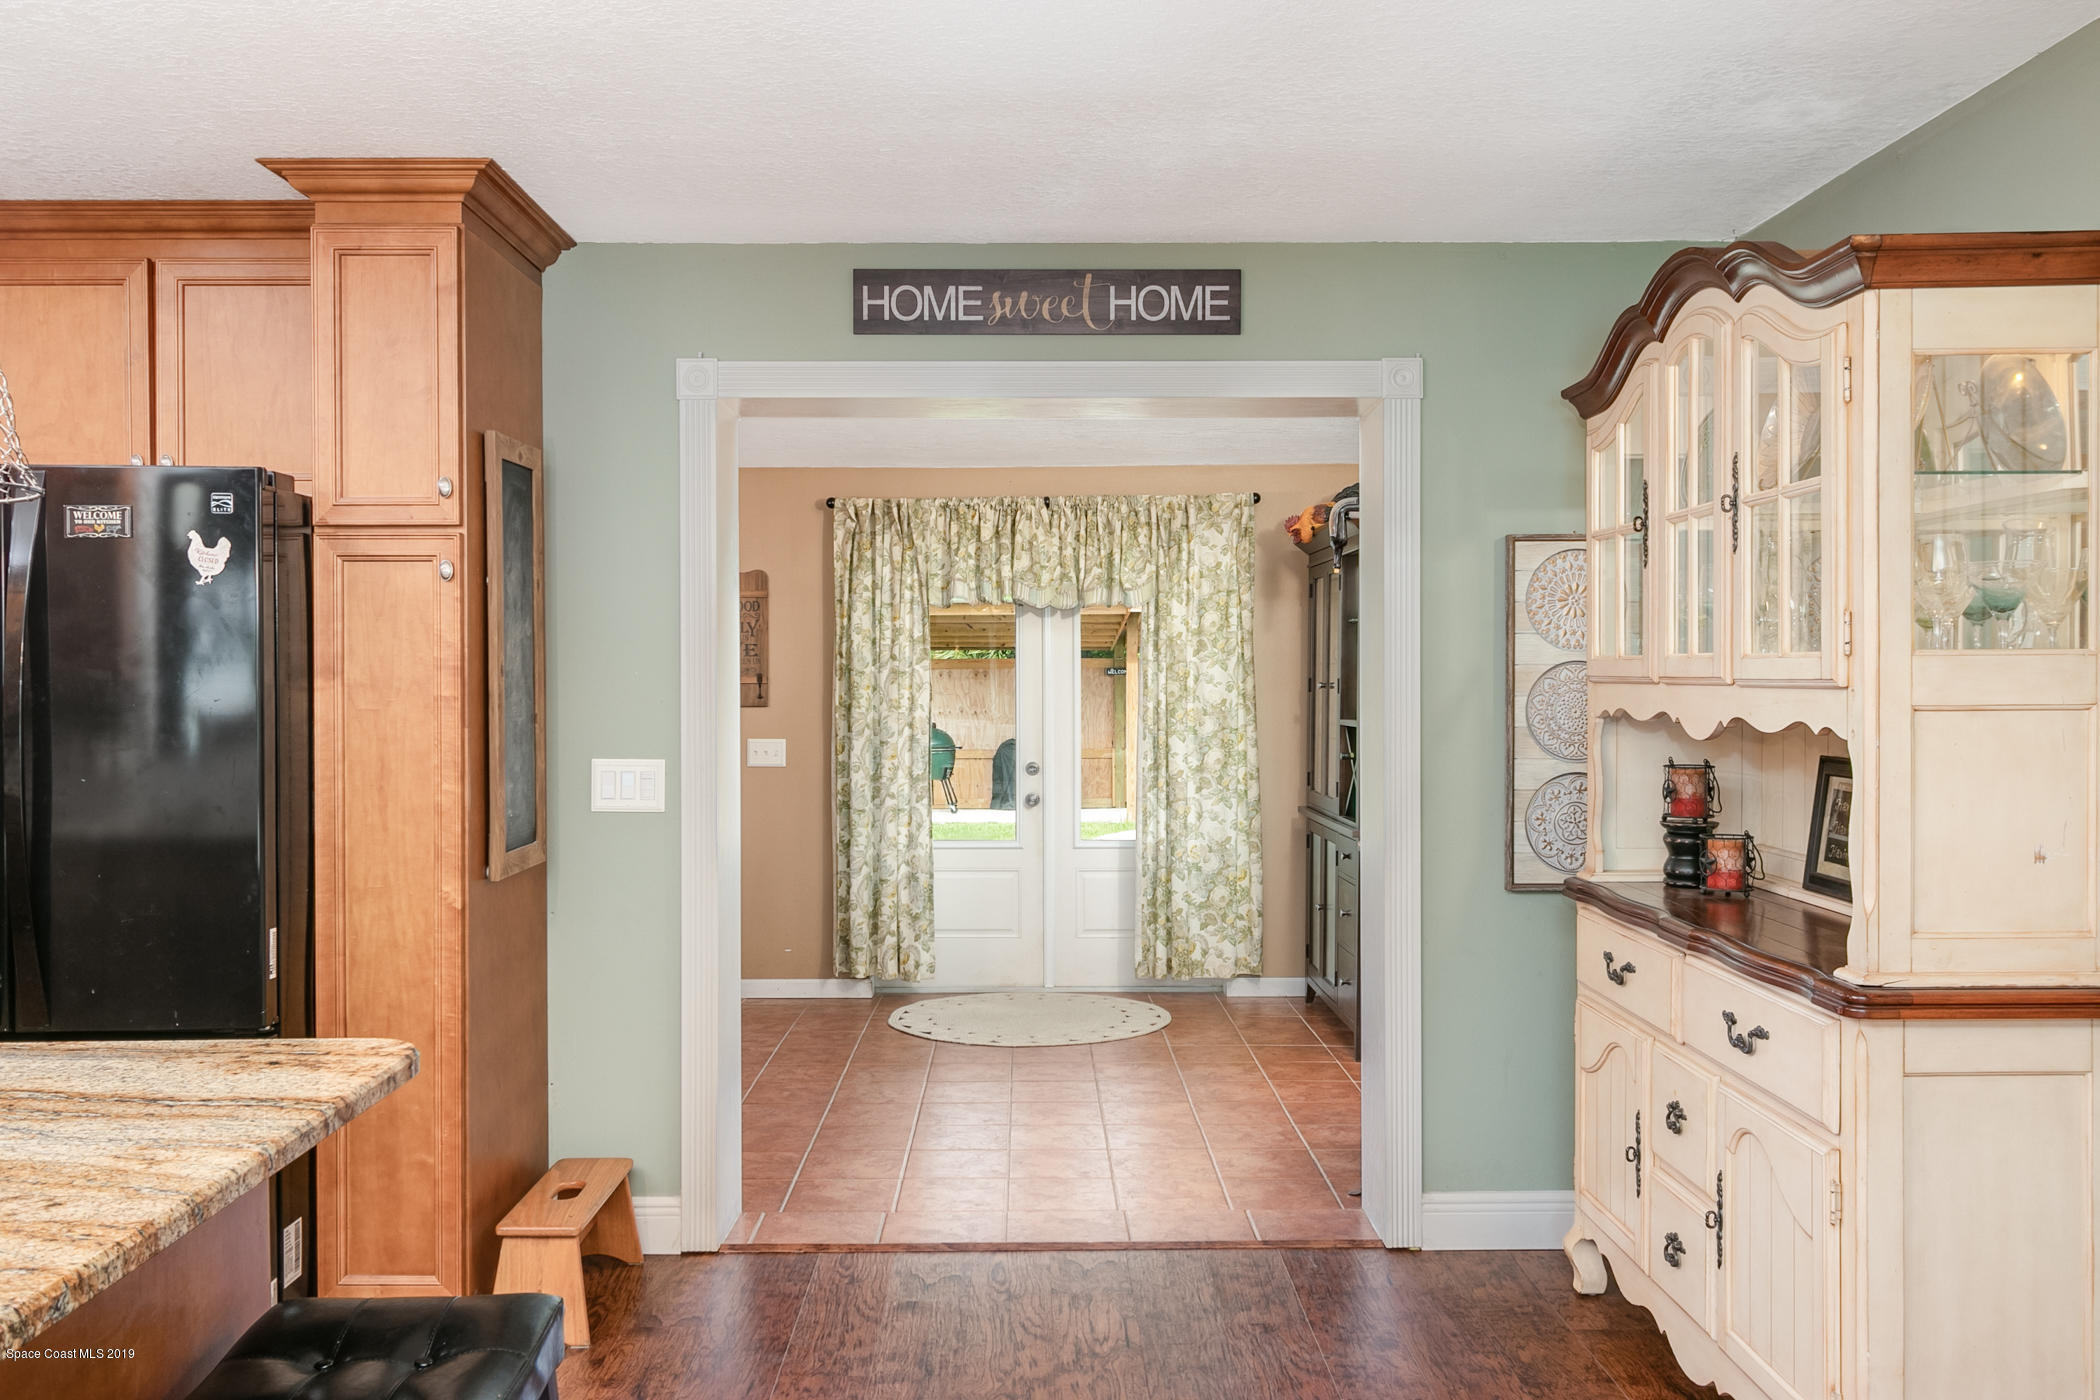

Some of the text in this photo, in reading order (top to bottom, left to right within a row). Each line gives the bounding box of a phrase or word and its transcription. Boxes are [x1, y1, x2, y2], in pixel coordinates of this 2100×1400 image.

[862, 273, 1231, 331] HOME sweet HOME
[73, 511, 122, 520] WELCOME
